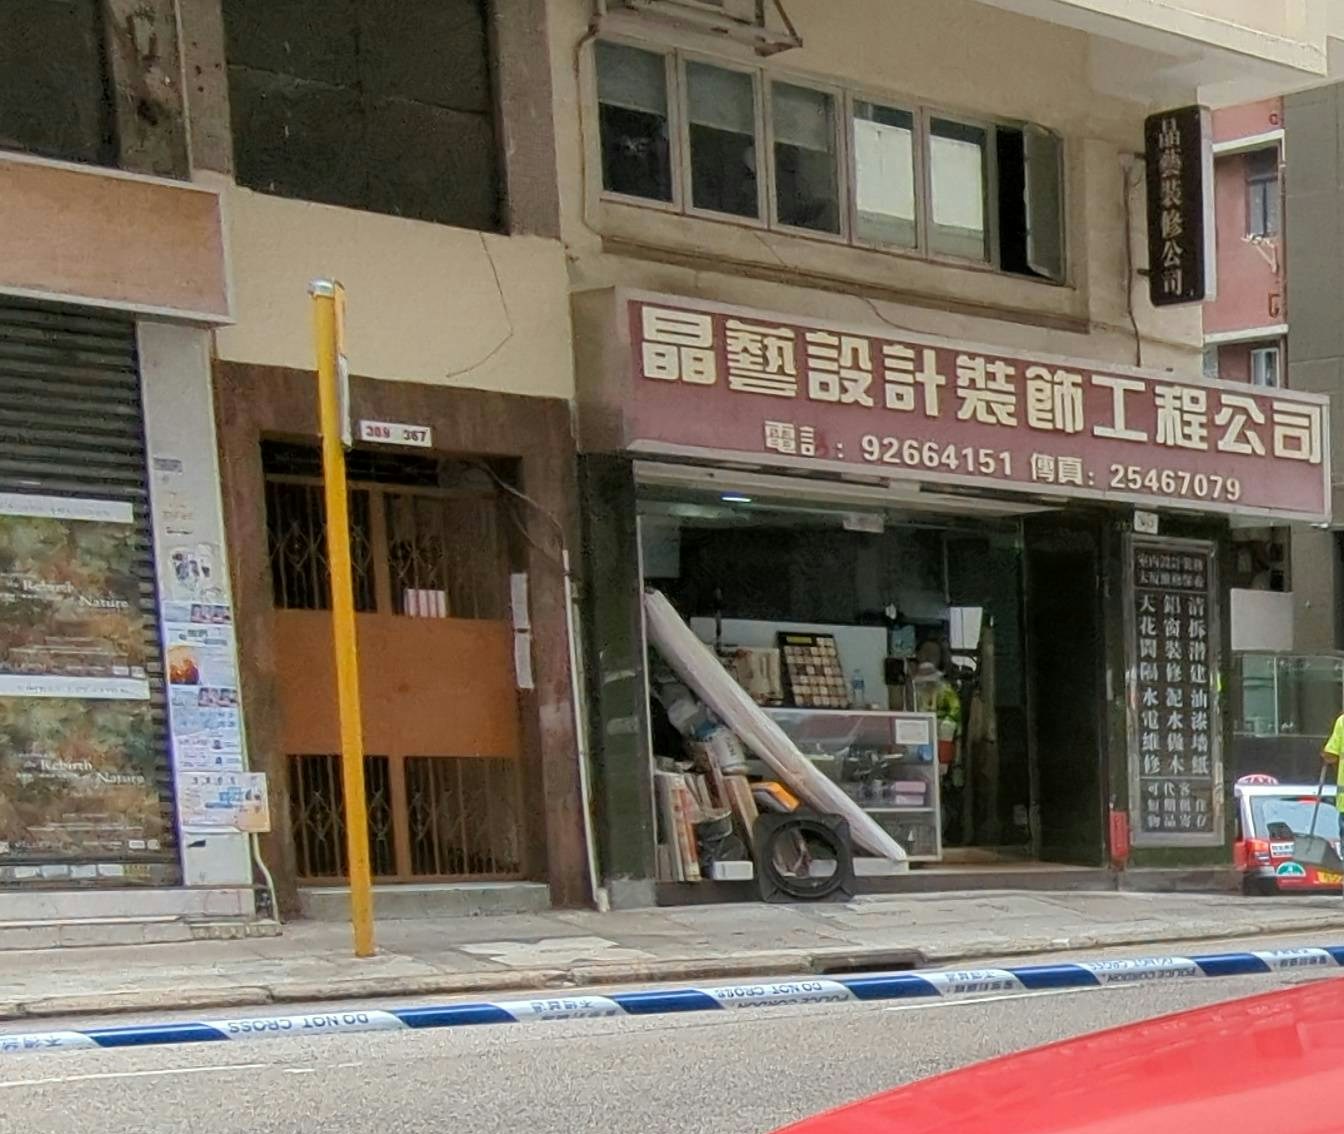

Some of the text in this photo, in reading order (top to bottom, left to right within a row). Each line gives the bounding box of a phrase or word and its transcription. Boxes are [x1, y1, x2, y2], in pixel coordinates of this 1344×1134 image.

[639, 305, 1323, 465] 晶藝設計裝飾工程公司
[862, 435, 1012, 475] 92664151
[1109, 465, 1241, 500] 25467079
[1159, 967, 1196, 980] POLICE
[227, 1013, 369, 1034] DO NOT CROSS
